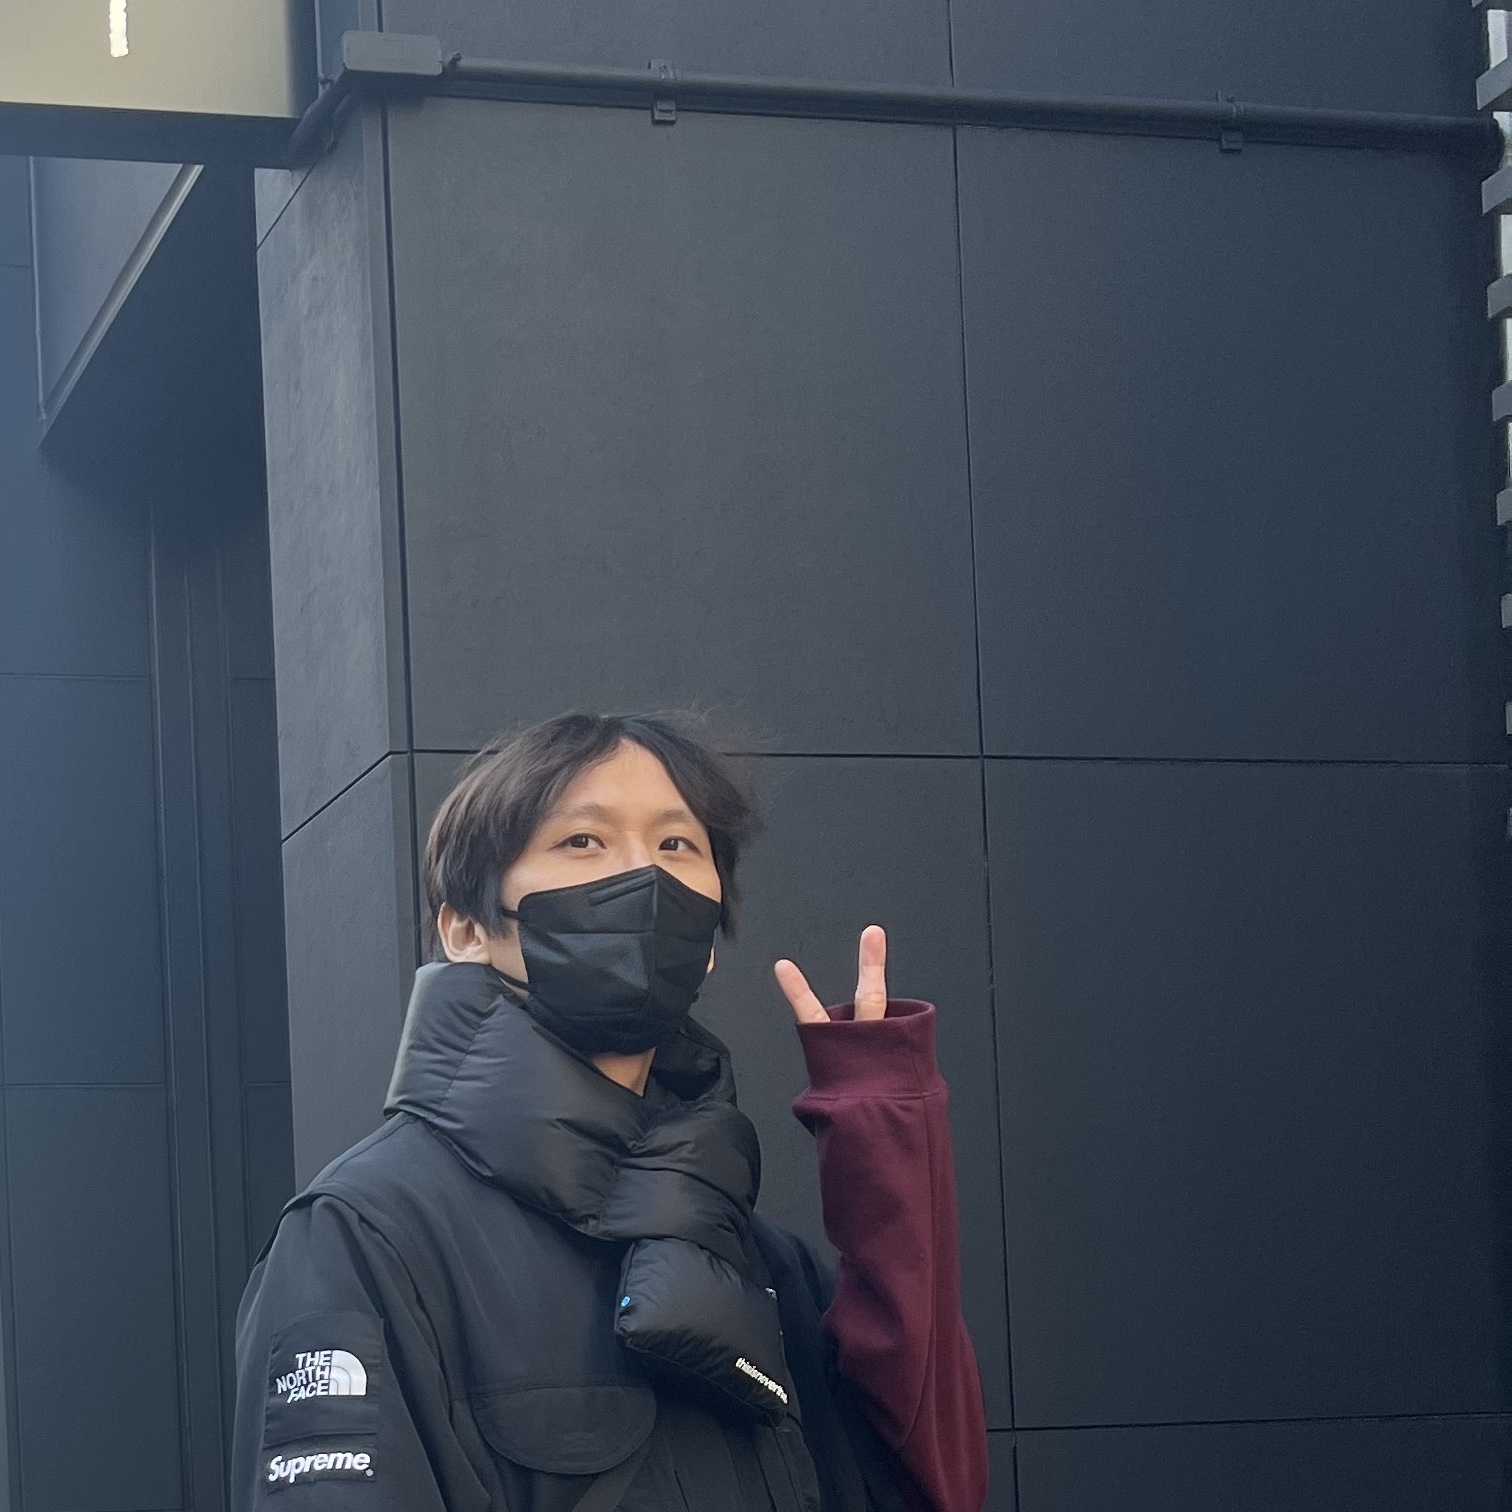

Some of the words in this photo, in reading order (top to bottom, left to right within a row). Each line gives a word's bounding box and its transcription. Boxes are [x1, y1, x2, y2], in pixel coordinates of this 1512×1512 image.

[295, 1350, 332, 1369] THE
[276, 1366, 330, 1395] NORTH
[287, 1380, 329, 1404] FACE
[268, 1450, 372, 1484] Supreme
